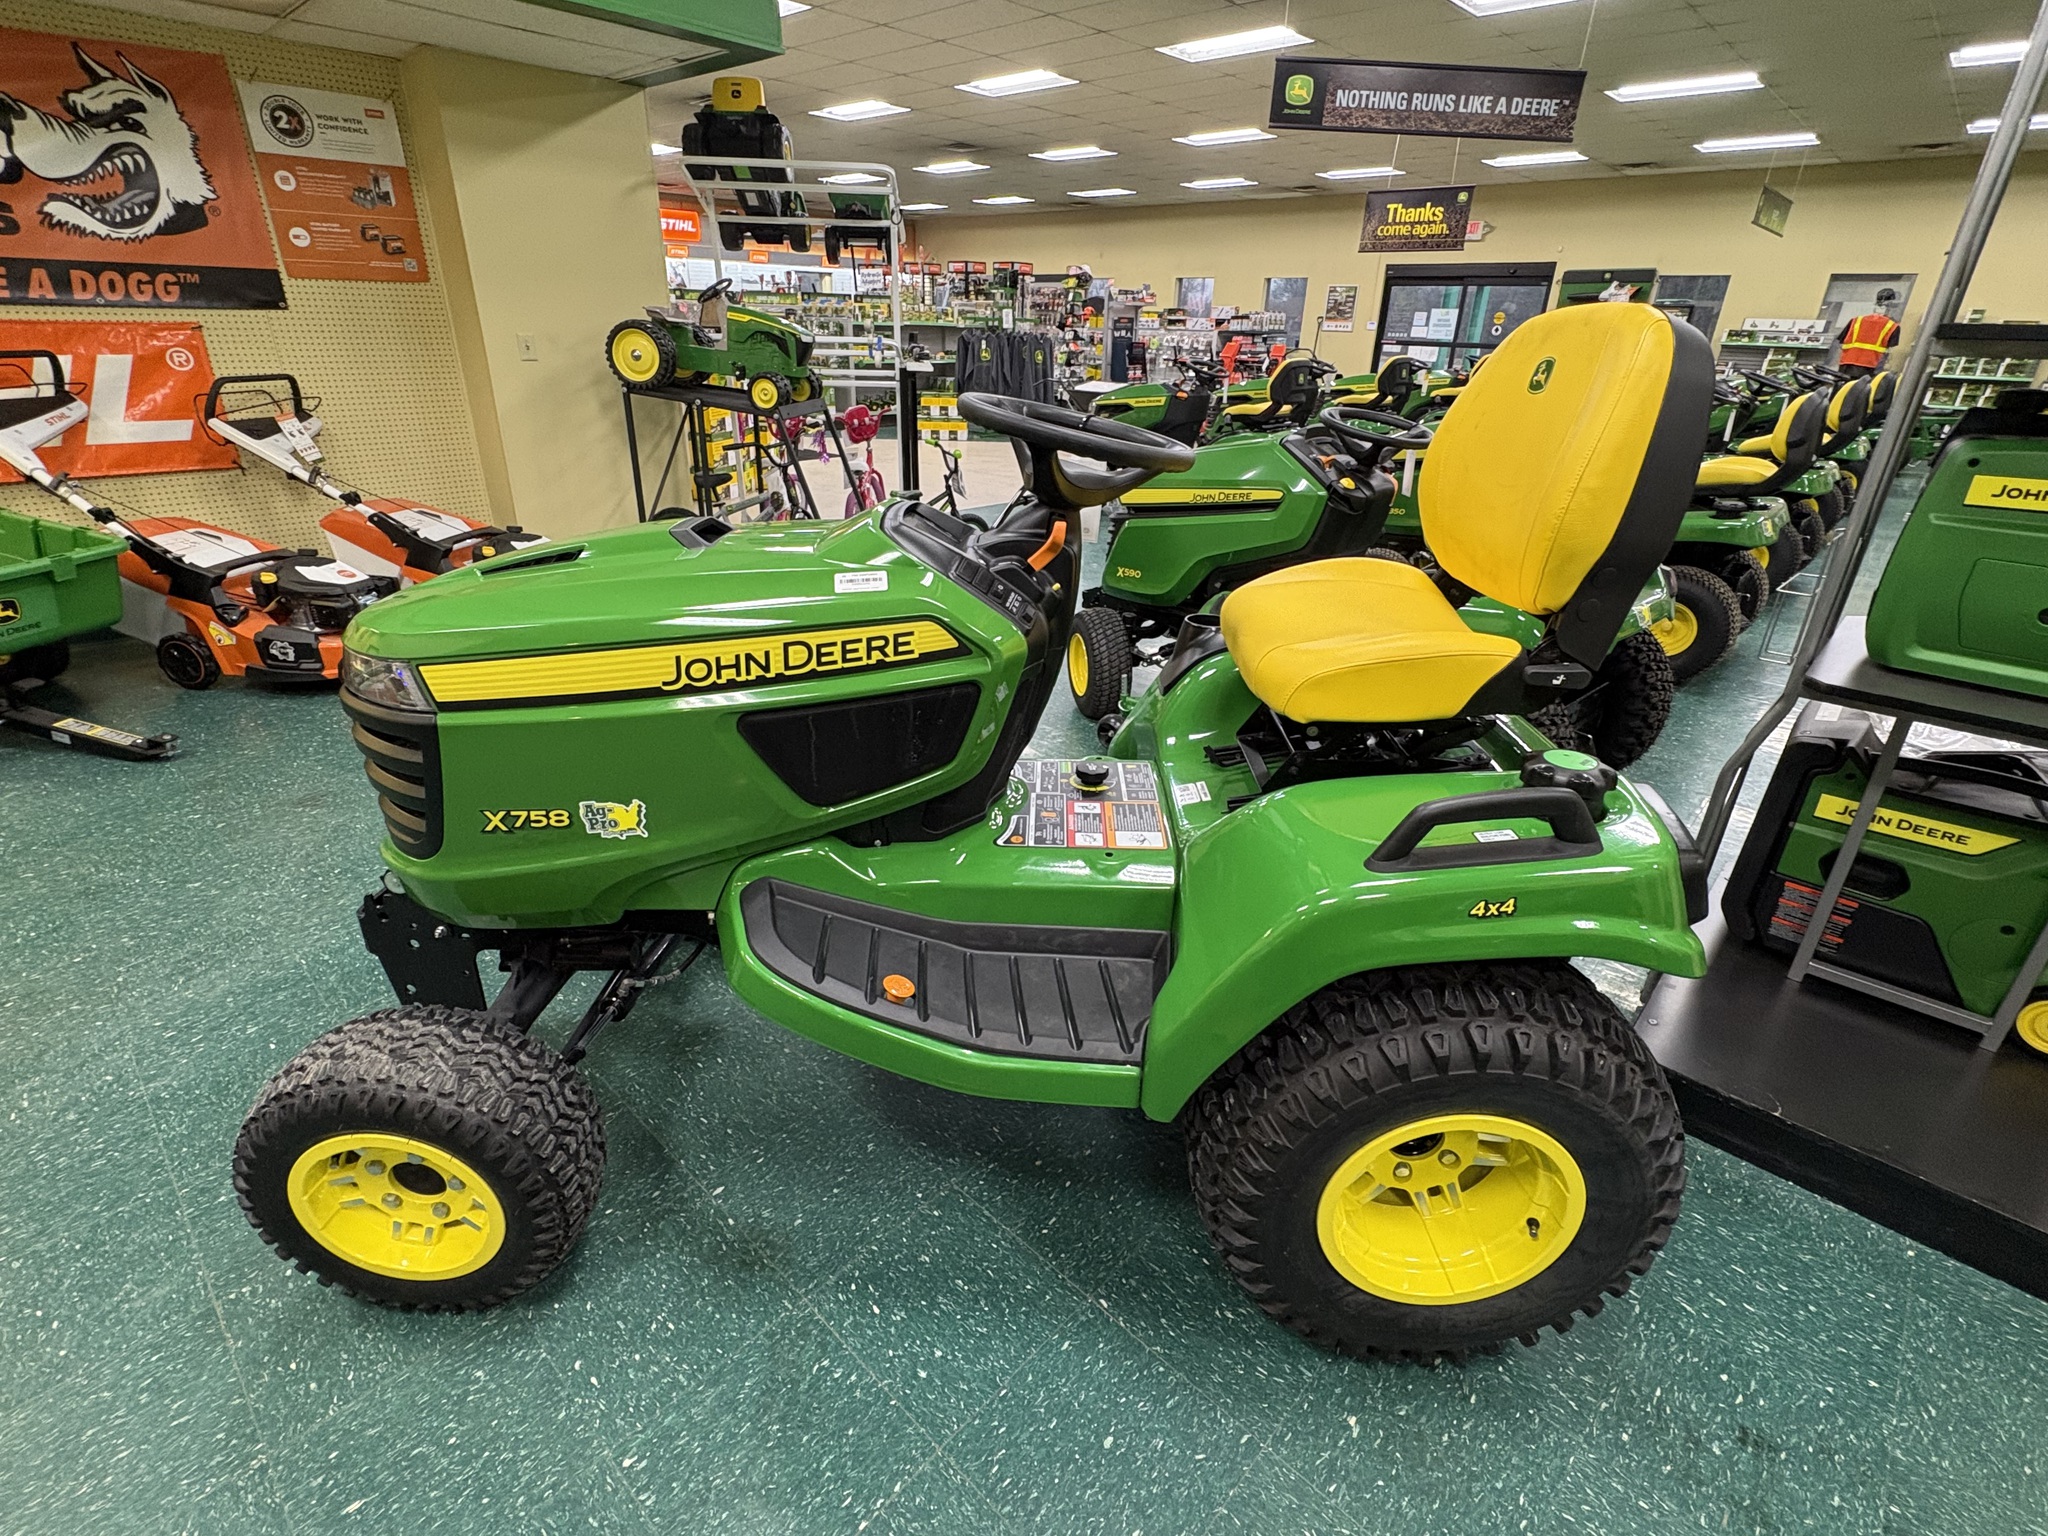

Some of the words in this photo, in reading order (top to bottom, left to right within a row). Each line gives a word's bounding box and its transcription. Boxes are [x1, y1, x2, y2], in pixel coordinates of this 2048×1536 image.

[1335, 89, 1408, 110] NOTHING
[1411, 92, 1455, 112] RUNS
[1458, 94, 1494, 114] LIKE
[1495, 96, 1508, 115] A
[314, 113, 340, 123] WORK
[341, 116, 363, 126] WITH
[317, 122, 369, 135] CONFIDENCE
[1386, 202, 1444, 223] Thanks
[661, 218, 697, 233] STIHL
[1377, 224, 1411, 236] come
[1412, 221, 1450, 238] again.
[1467, 222, 1481, 234] XIT
[28, 267, 57, 299] A
[44, 411, 71, 427] STIHL
[1190, 493, 1216, 503] JOHN
[1217, 492, 1252, 502] DEERE
[1116, 566, 1142, 579] X590
[6, 621, 42, 637] DEERE
[660, 648, 772, 688] JOHN
[783, 631, 917, 673] DEERE
[584, 804, 613, 819] Ag-
[481, 808, 572, 833] X758
[587, 817, 618, 831] Pro
[1836, 805, 1892, 827] JON
[1896, 818, 1971, 846] DEERE
[1469, 897, 1517, 917] 4x4
